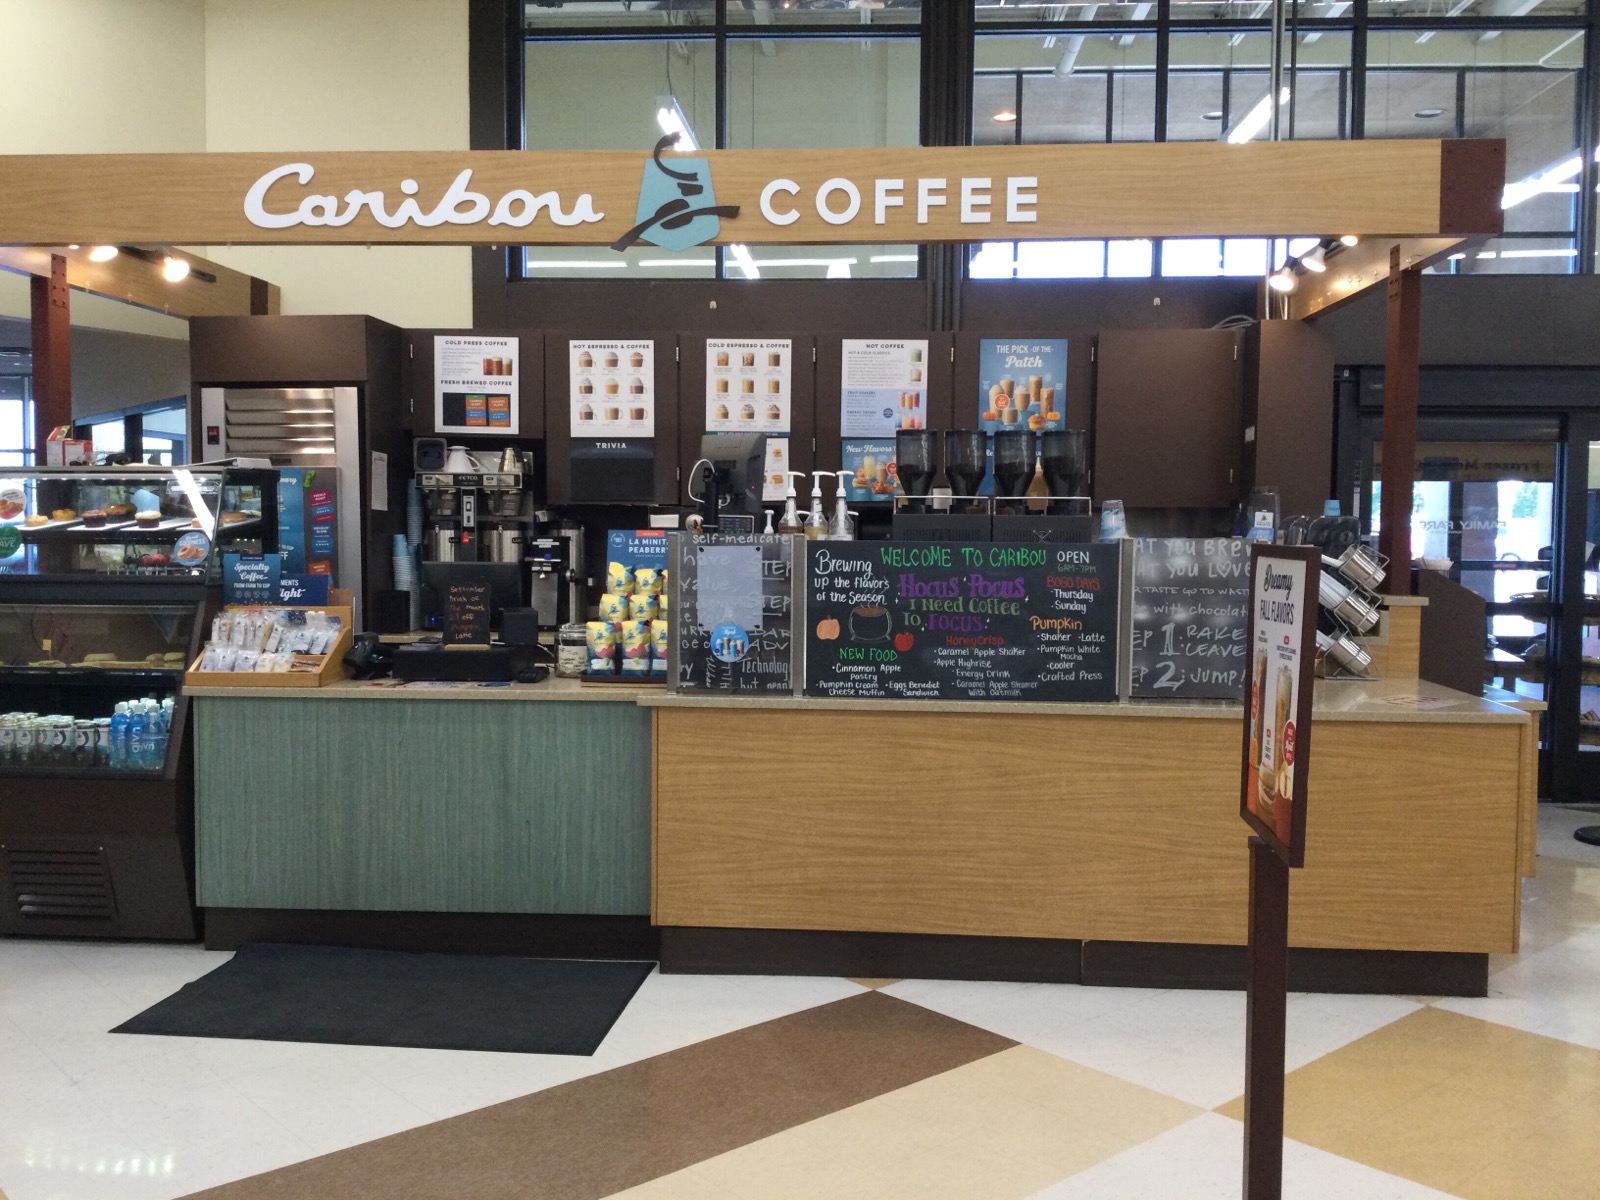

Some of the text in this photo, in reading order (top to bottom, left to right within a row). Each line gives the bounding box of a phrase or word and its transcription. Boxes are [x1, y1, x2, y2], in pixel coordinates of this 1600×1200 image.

[244, 163, 1038, 228] Caribou COFFEE
[996, 345, 1009, 354] THE
[1011, 345, 1029, 354] PICK
[1005, 355, 1044, 368] Patch
[845, 445, 892, 453] New Flavors
[628, 546, 668, 554] PEABERR
[880, 546, 1047, 567] WELCOME TO CARIBOU
[1057, 550, 1090, 564] OPEN
[234, 562, 270, 572] Specialty
[815, 549, 873, 580] Brewing
[1057, 564, 1097, 573] 6AM-7PM
[239, 572, 268, 582] Coffee
[834, 576, 850, 588] the
[854, 576, 890, 589] flavors
[1046, 575, 1101, 591] BOGO DAYS
[1263, 564, 1293, 601] Dreamy
[816, 591, 827, 601] of
[829, 592, 847, 603] the
[1053, 588, 1094, 603] Thursday
[1143, 586, 1180, 594] TASTE
[1183, 588, 1197, 596] GO
[1218, 587, 1249, 595] WAST
[1055, 600, 1087, 615] Sunday
[1153, 602, 1248, 617] with chocolat
[1260, 599, 1295, 625] FALL FLAVORS
[1081, 633, 1106, 643] Latte
[1187, 625, 1247, 640] RAKE
[839, 647, 898, 661] NEW FOOD
[937, 647, 969, 656] Caramel
[973, 647, 996, 657] Apple
[1077, 645, 1101, 653] White
[1060, 653, 1083, 661] Mocha
[835, 662, 902, 674] Cinnamon Apple
[936, 658, 992, 669] Apple Highrise
[956, 669, 984, 680] Energy
[1041, 670, 1103, 682] Crafted Press
[889, 681, 907, 691] Eggs
[989, 681, 1009, 690] Apple
